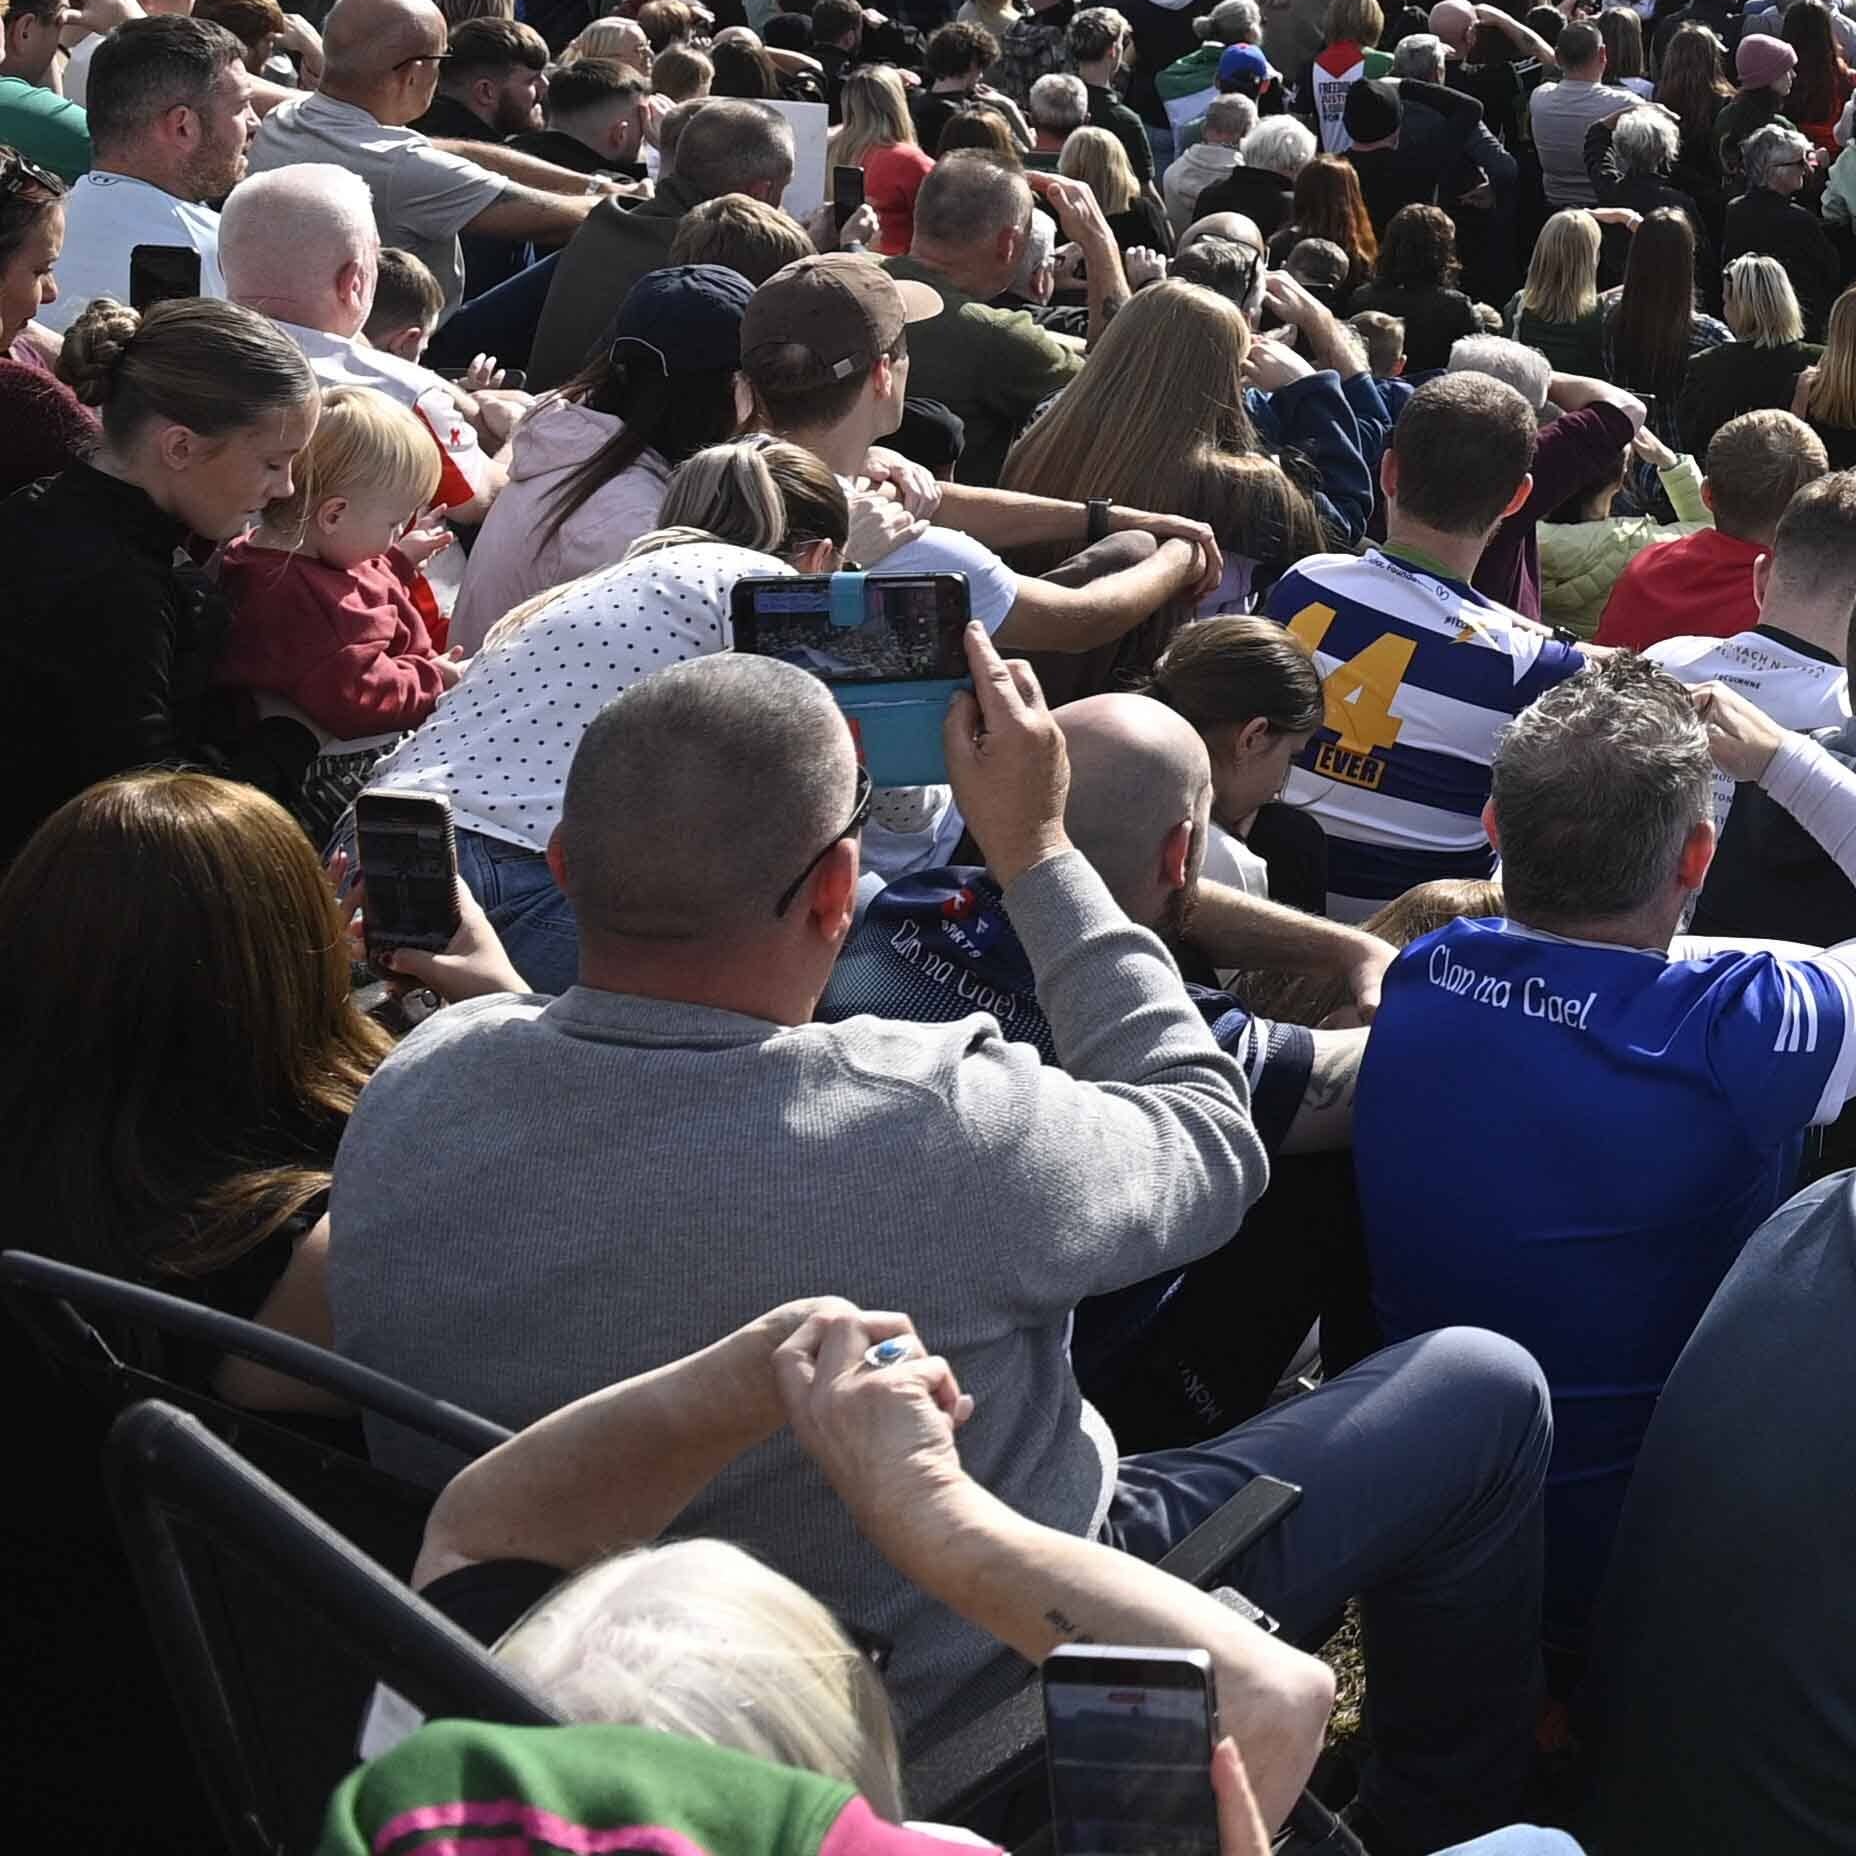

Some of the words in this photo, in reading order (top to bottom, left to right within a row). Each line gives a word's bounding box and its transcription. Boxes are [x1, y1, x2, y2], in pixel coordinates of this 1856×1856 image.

[1318, 745, 1383, 785] EVER
[921, 951, 955, 985] na
[1429, 943, 1476, 995] Clan
[1474, 975, 1512, 1009] na
[1522, 976, 1598, 1031] Gael
